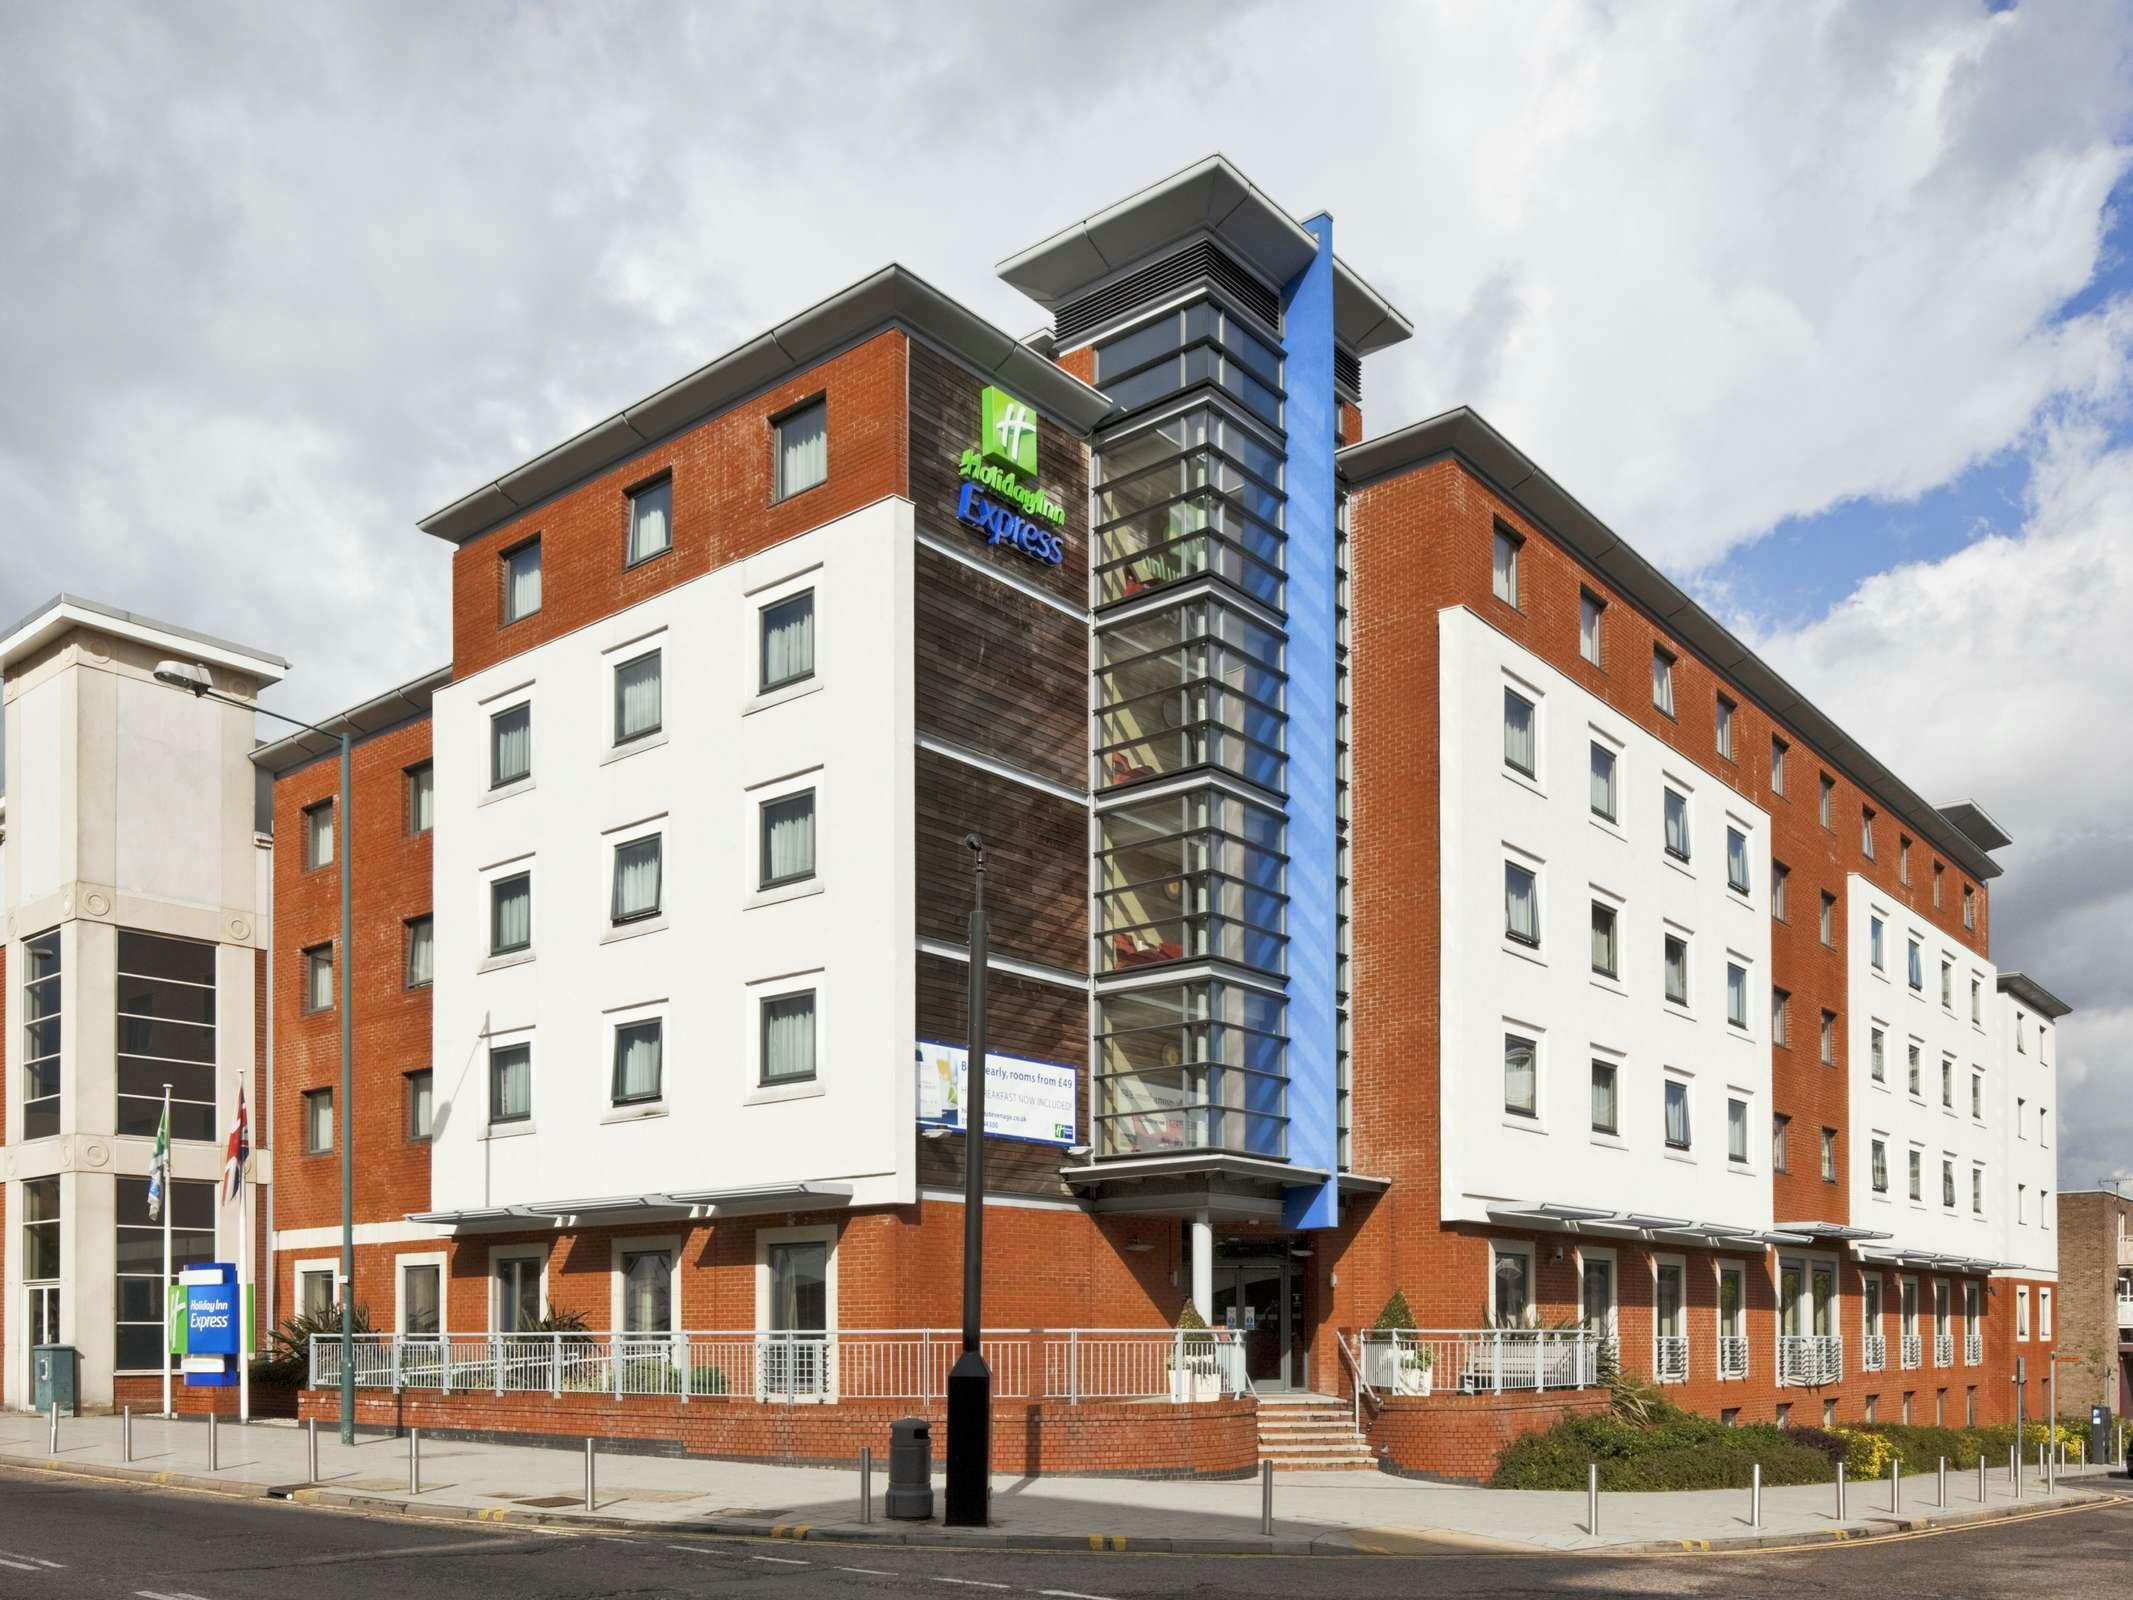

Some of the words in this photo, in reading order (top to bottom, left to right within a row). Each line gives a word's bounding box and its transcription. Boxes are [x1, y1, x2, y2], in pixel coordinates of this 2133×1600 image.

[957, 482, 1064, 566] Express
[985, 1066, 1008, 1081] early,
[1009, 1071, 1036, 1083] rooms
[1037, 1073, 1057, 1086] from
[1058, 1077, 1073, 1089] £49
[190, 1300, 215, 1312] Holiday
[215, 1298, 228, 1310] Inn
[190, 1313, 228, 1332] Express
